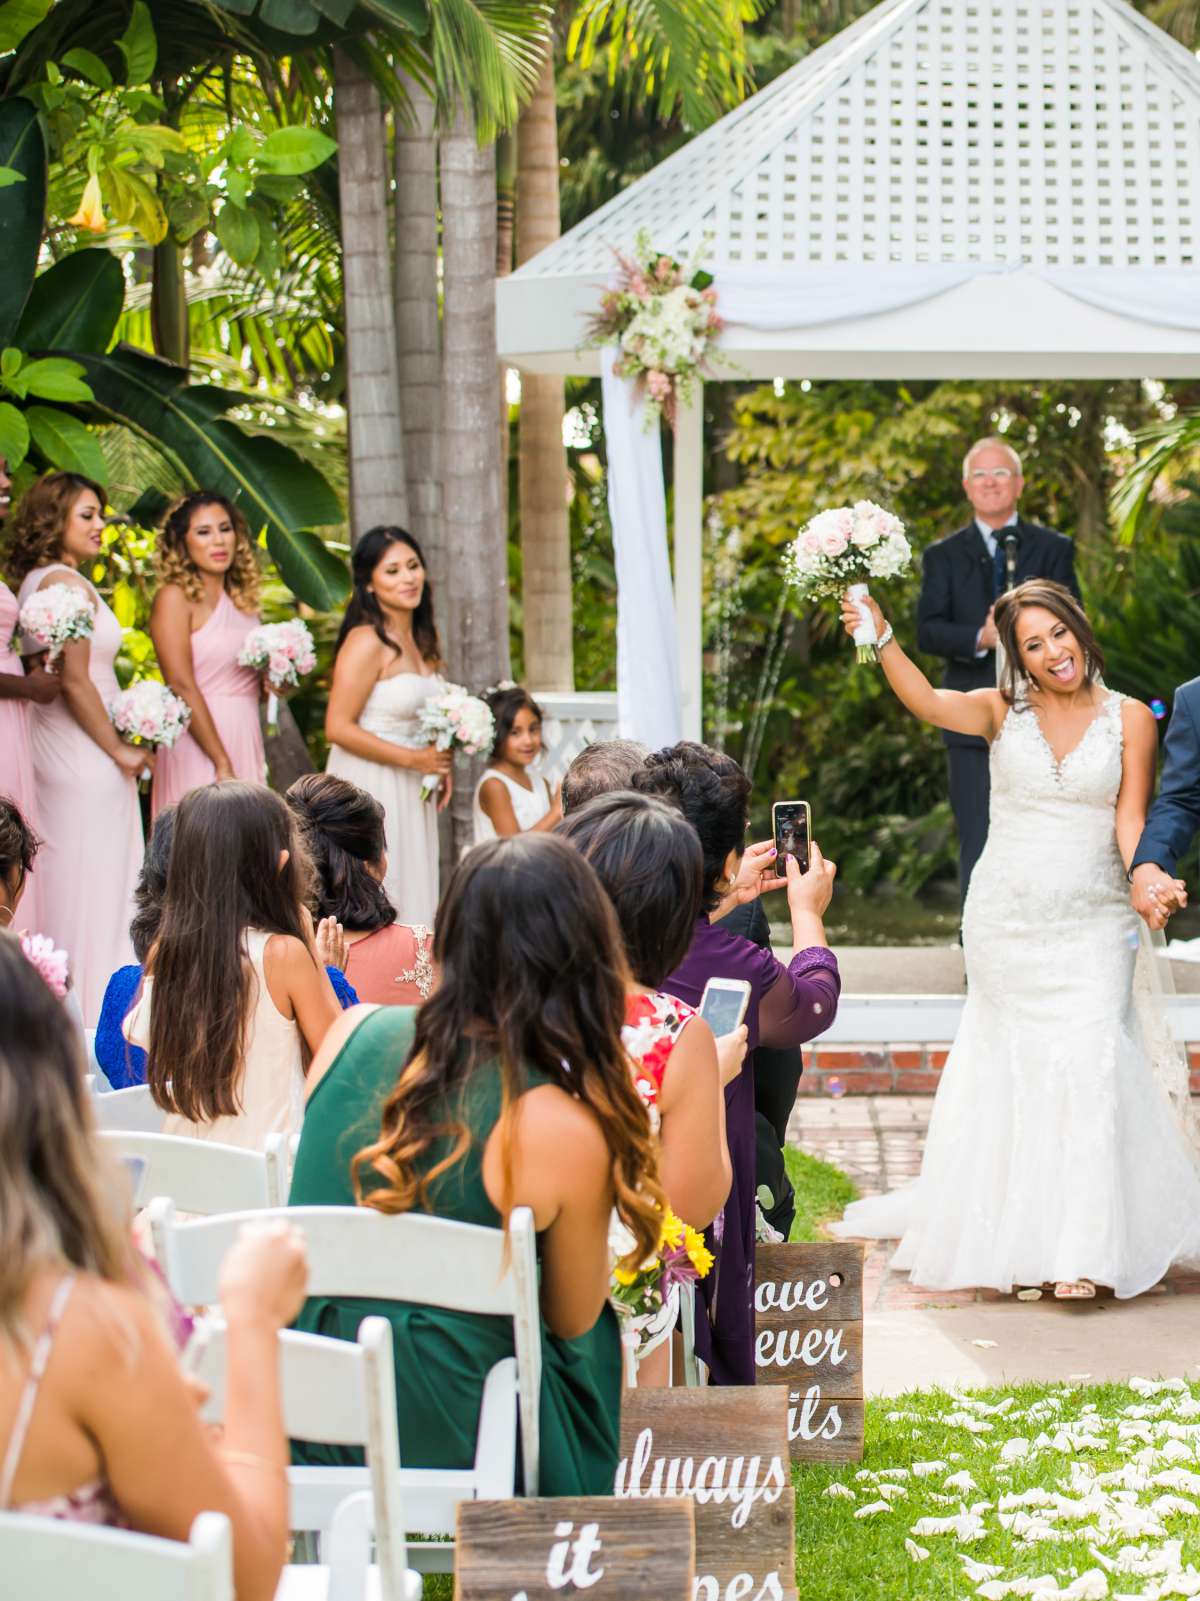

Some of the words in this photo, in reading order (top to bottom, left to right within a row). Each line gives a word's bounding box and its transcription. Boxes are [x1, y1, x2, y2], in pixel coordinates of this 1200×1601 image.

[755, 1279, 828, 1312] ove
[755, 1328, 847, 1367] ever
[546, 1521, 604, 1589] it
